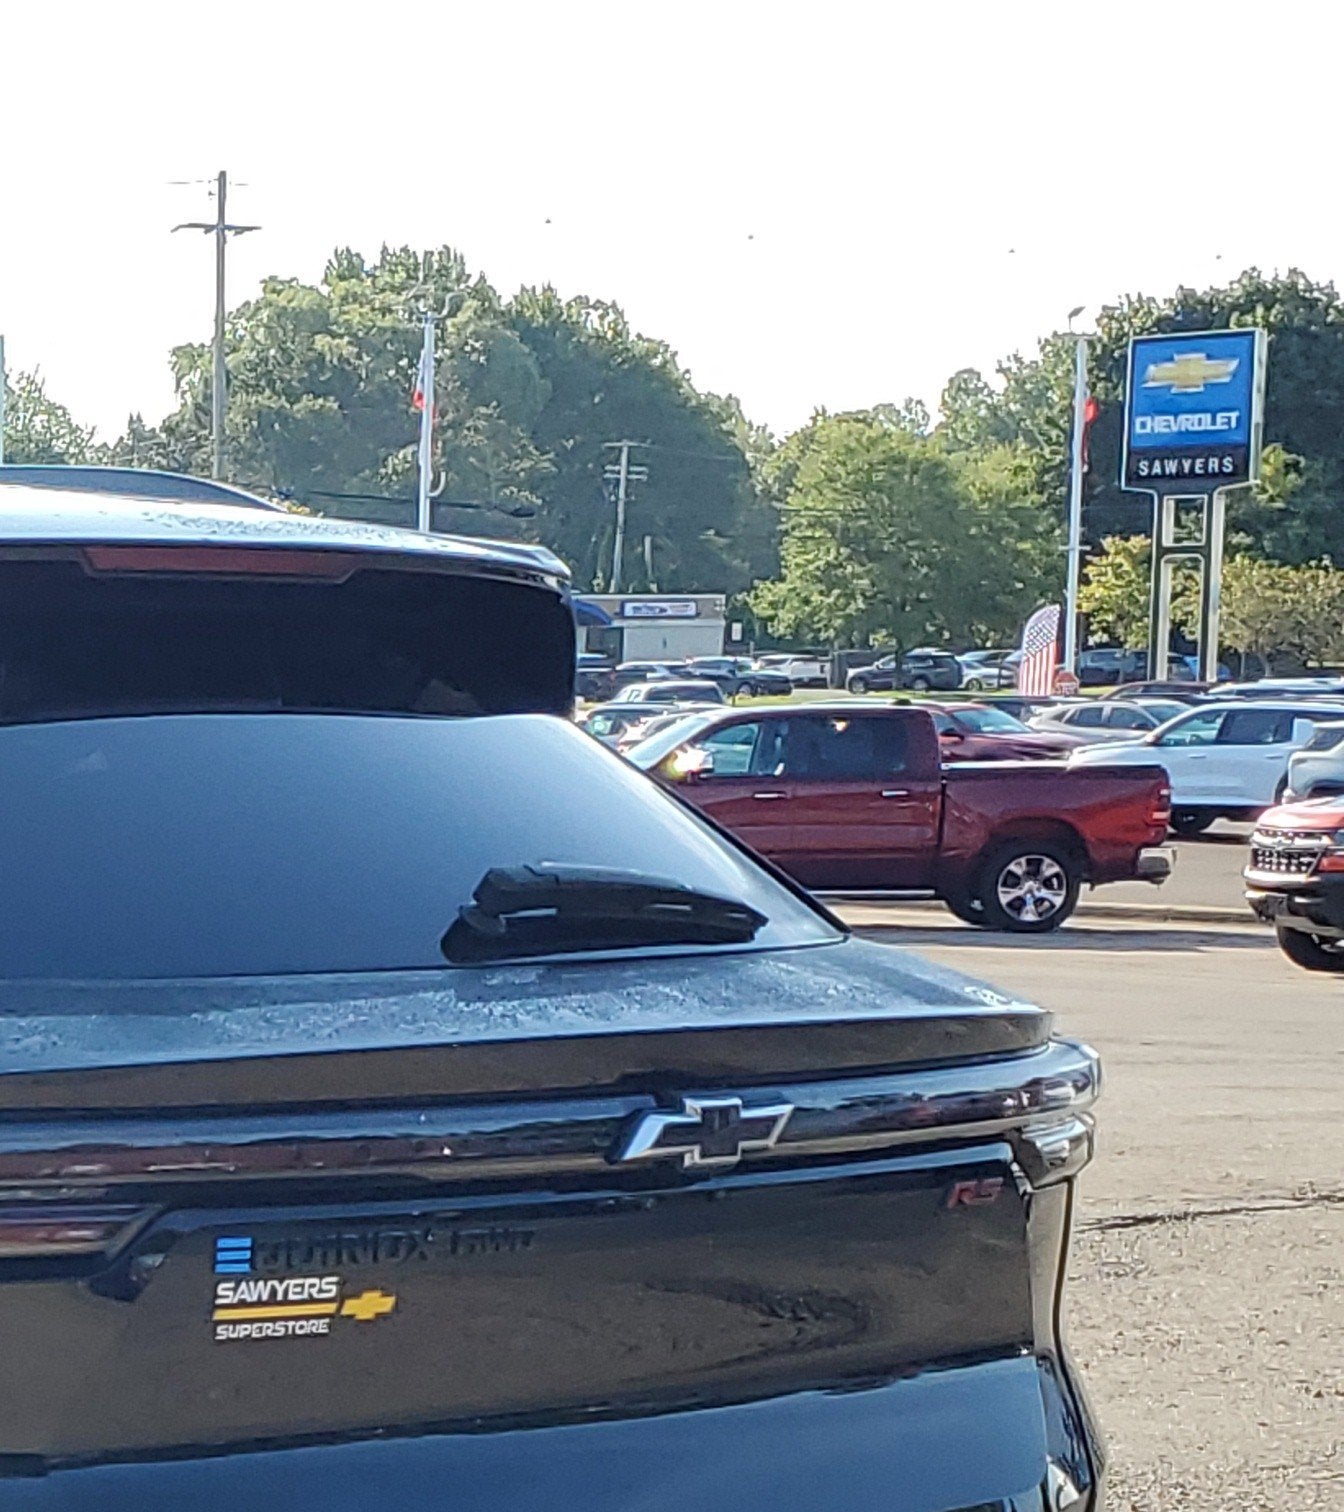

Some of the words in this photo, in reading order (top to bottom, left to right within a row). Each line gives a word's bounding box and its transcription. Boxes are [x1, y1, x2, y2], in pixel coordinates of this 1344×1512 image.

[1134, 410, 1240, 433] CHEVROLET
[1138, 456, 1234, 476] SAWYERS
[946, 1176, 1004, 1209] RS
[215, 1276, 340, 1304] SAWYERS
[215, 1318, 330, 1340] SUPERSTORE
